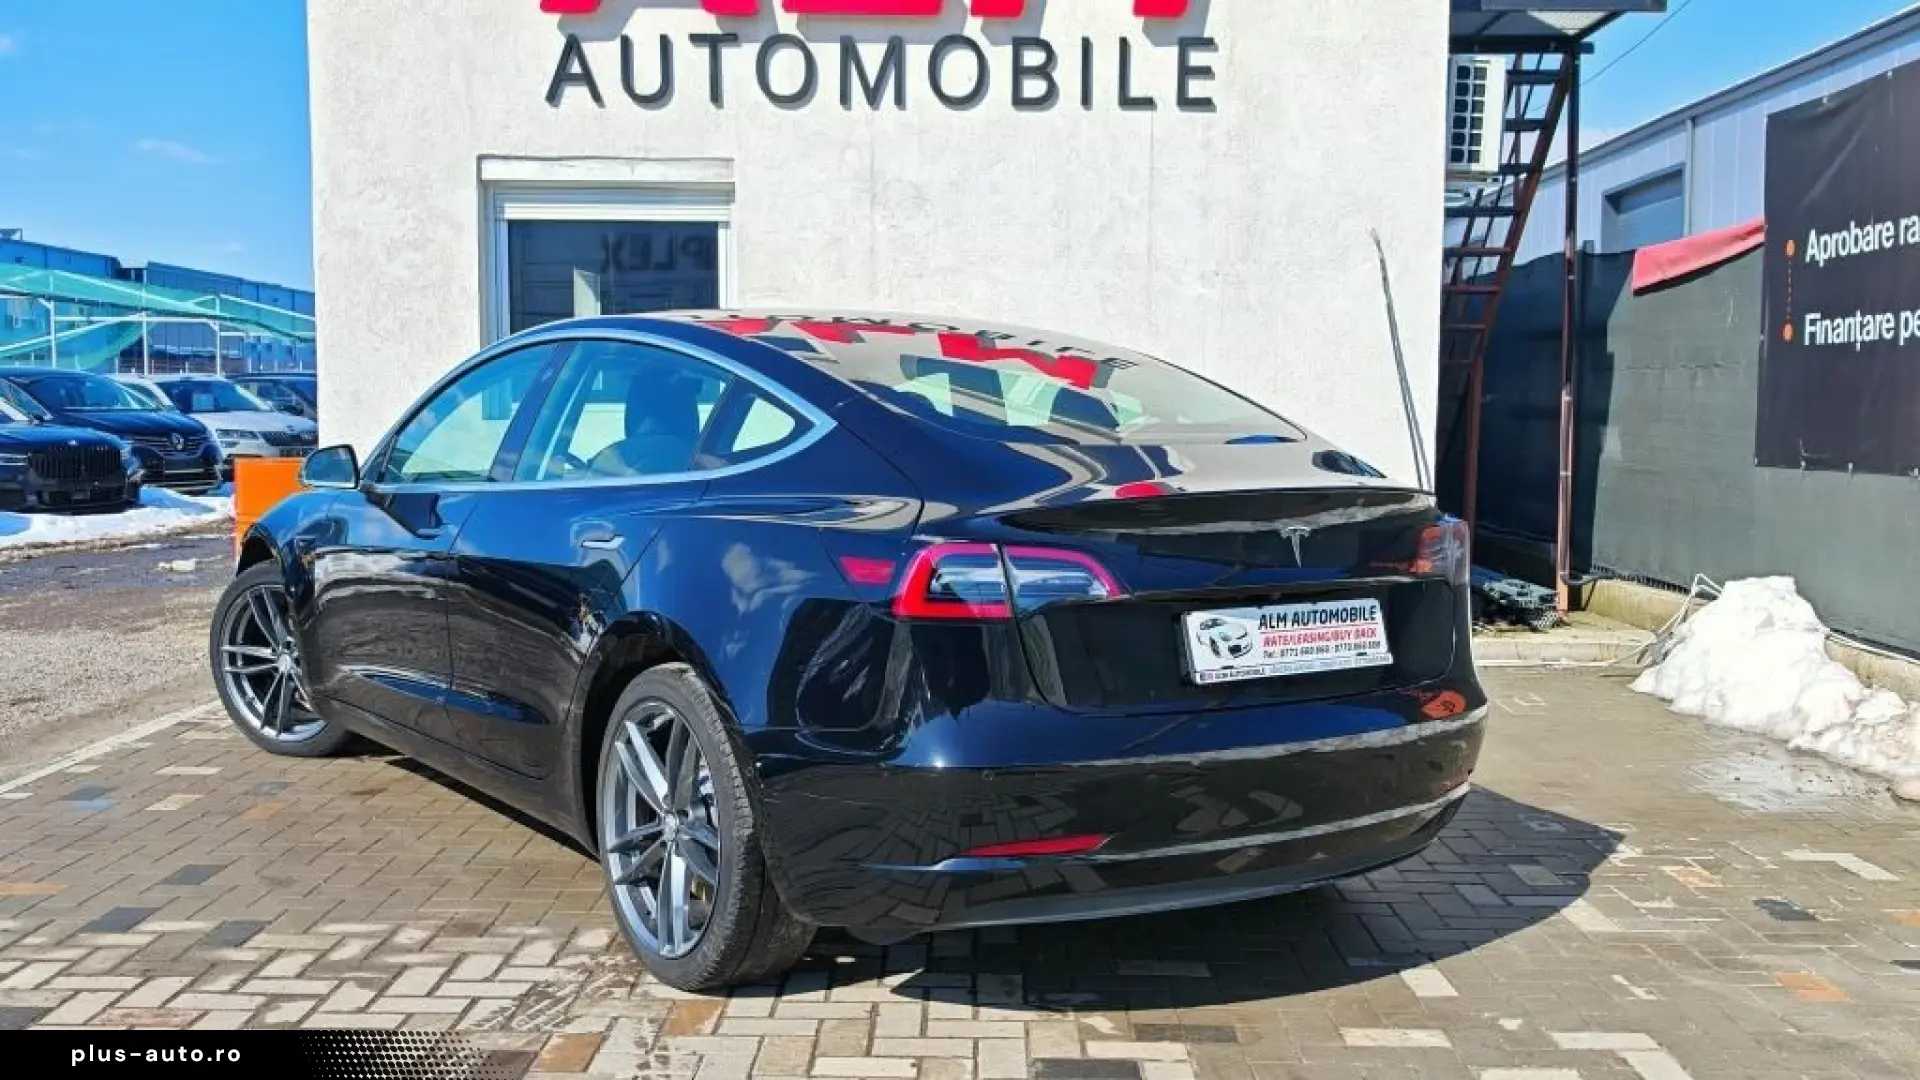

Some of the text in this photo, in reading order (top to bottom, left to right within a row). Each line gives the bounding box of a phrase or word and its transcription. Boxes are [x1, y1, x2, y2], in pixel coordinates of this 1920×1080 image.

[545, 33, 1217, 112] AUTOMOBILE
[1805, 220, 1895, 268] Aprobare
[1258, 604, 1377, 630] ALM AUTOMOBILE
